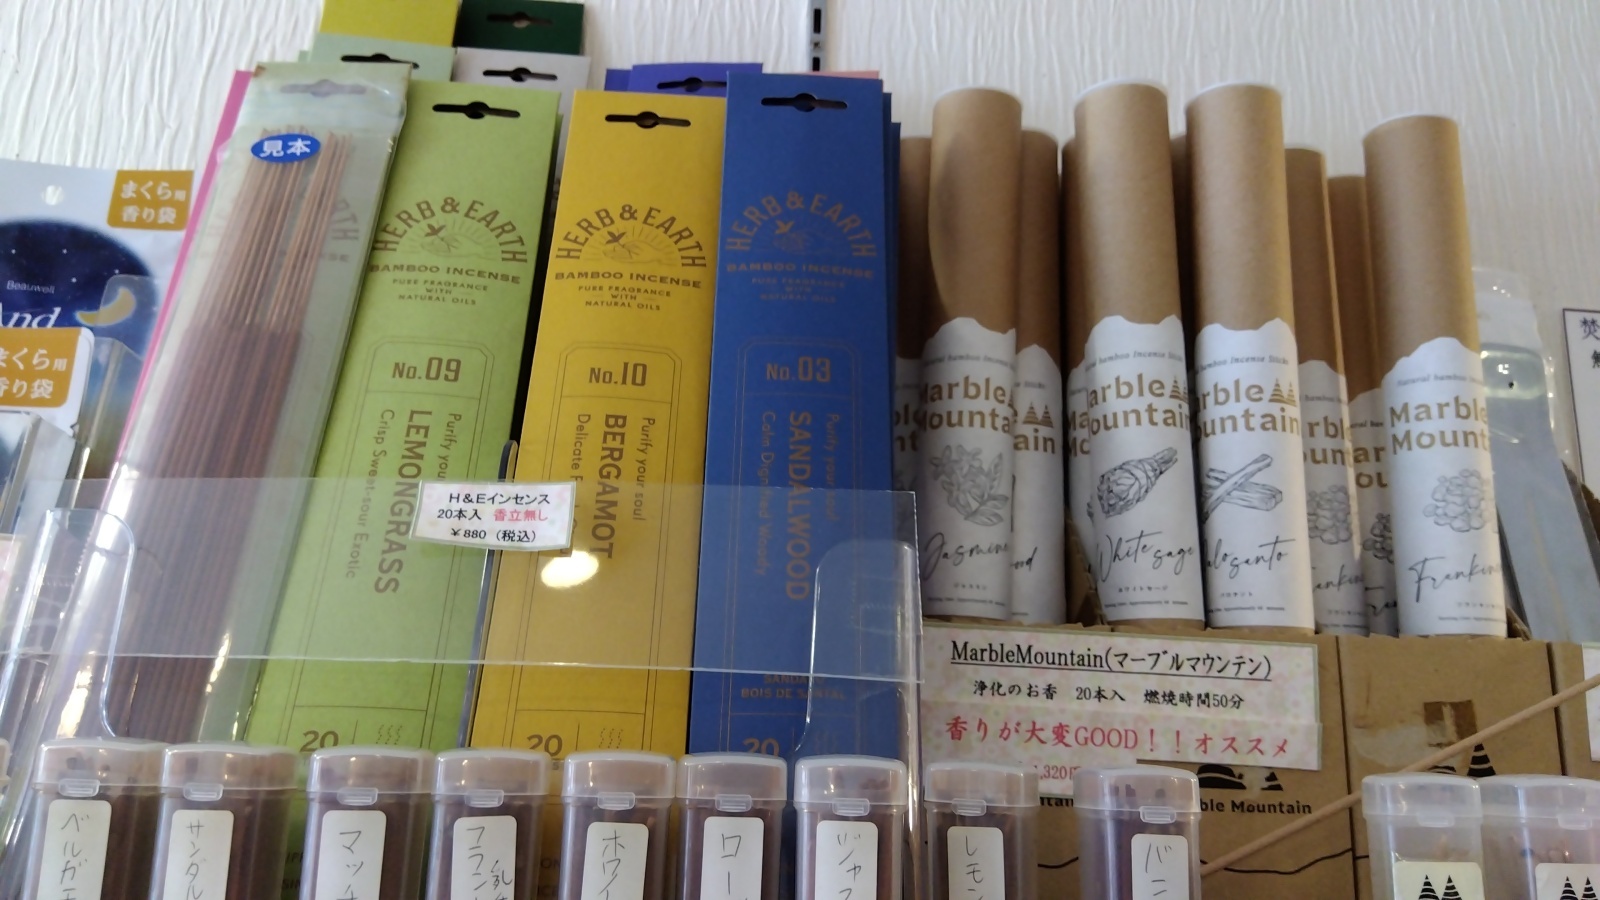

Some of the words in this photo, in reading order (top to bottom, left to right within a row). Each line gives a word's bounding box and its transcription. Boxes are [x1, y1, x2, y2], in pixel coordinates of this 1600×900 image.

[260, 138, 311, 157] 見本
[121, 181, 186, 201] まくら用
[122, 205, 177, 224] 香り袋
[726, 196, 782, 251] HERB
[786, 191, 804, 209] &
[810, 193, 877, 257] EARTH
[373, 200, 435, 251] HERB
[441, 196, 460, 214] &
[464, 200, 527, 263] EARTH
[556, 208, 615, 259] HERB
[619, 204, 637, 221] &
[642, 207, 706, 268] EARTH
[368, 264, 440, 273] BAMBOO
[446, 267, 521, 284] INCENSE
[555, 271, 623, 280] BAMBOO
[630, 273, 702, 289] INCENSE
[727, 262, 796, 272] BAMBOO
[802, 264, 874, 279] INCENSE
[6, 279, 56, 294] Beauwell
[424, 279, 488, 291] FRAGRANCE
[608, 285, 671, 297] FRAGRANCE
[398, 294, 445, 302] NATURAL
[452, 297, 476, 305] OILS
[585, 300, 632, 308] NATURAL
[637, 303, 660, 311] OILS
[0, 301, 61, 328] nd
[392, 357, 461, 383] No.09
[588, 362, 647, 387] No.10
[766, 356, 831, 383] No.03
[1390, 395, 1487, 428] Marble
[373, 409, 395, 444] Crisp
[440, 413, 462, 450] Purify
[636, 417, 655, 454] Purify
[761, 411, 776, 447] Calm
[824, 413, 840, 451] Purify
[571, 413, 591, 470] Delicate
[589, 413, 627, 559] BERGAMOT
[635, 459, 647, 488] your
[357, 449, 387, 527] Sweet-sour
[374, 409, 432, 594] LEMONGRASS
[448, 493, 550, 505] H&Eインセンス
[437, 508, 482, 521] 20本入
[493, 508, 548, 522] 香立無し
[633, 492, 646, 521] soul
[785, 411, 812, 600] SANDALWOOD
[346, 532, 369, 578] Exotic
[741, 687, 772, 698] BOIS
[776, 688, 792, 698] DE
[973, 680, 1058, 700] 浄化のお香
[1076, 686, 1126, 703] 20本入
[1144, 689, 1244, 709] 燃焼時間50分
[300, 730, 339, 752] 20
[527, 734, 563, 757] 20
[1231, 799, 1312, 814] Mountain
[466, 826, 487, 900] フラン
